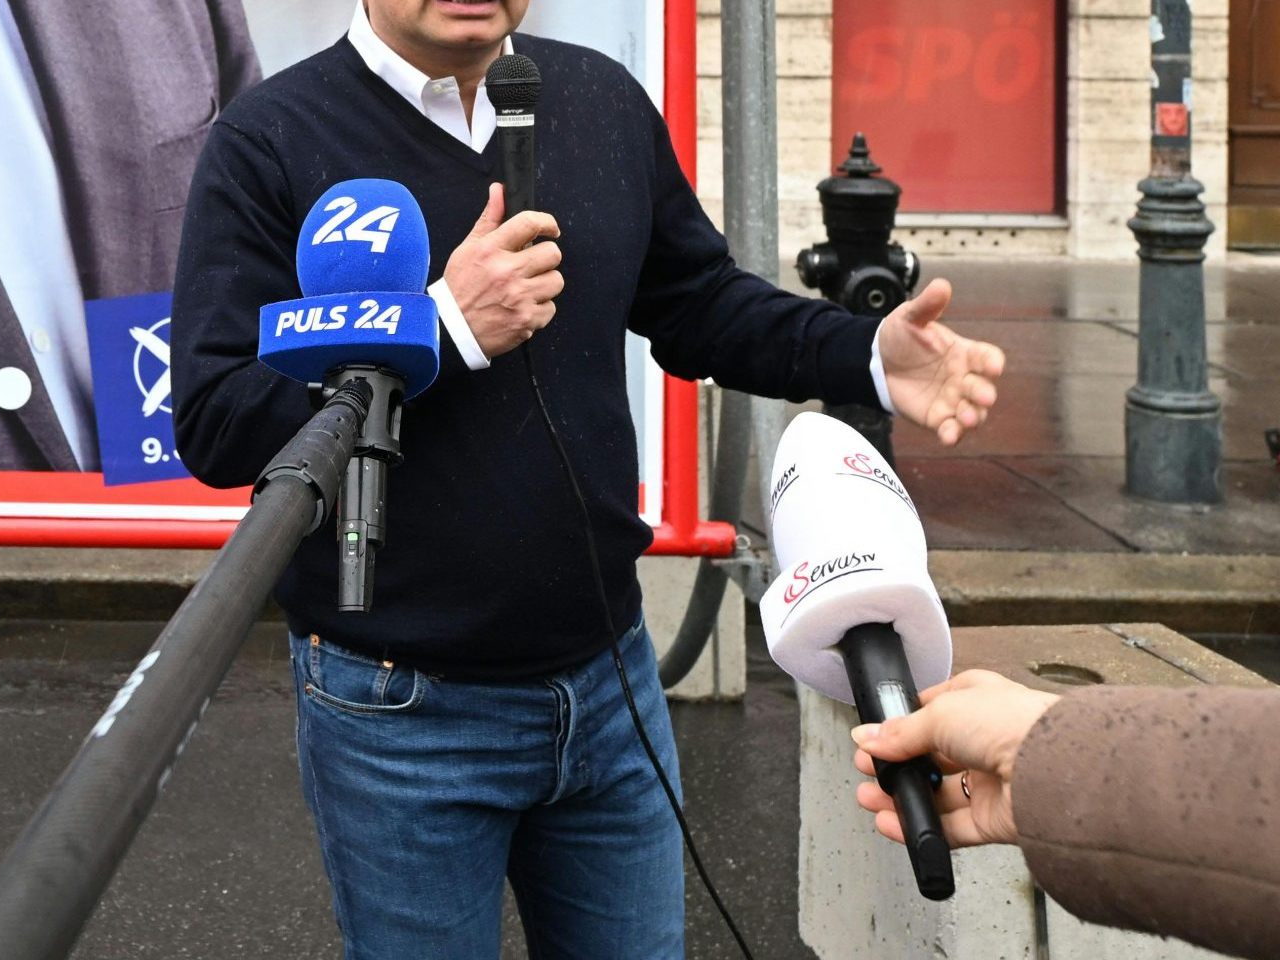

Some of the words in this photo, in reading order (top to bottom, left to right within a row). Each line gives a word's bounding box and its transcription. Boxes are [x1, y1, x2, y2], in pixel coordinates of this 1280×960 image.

[838, 12, 1044, 104] SPÖ
[311, 196, 401, 254] 24
[275, 305, 348, 337] PULS
[354, 299, 402, 335] 24
[141, 437, 171, 464] 9.
